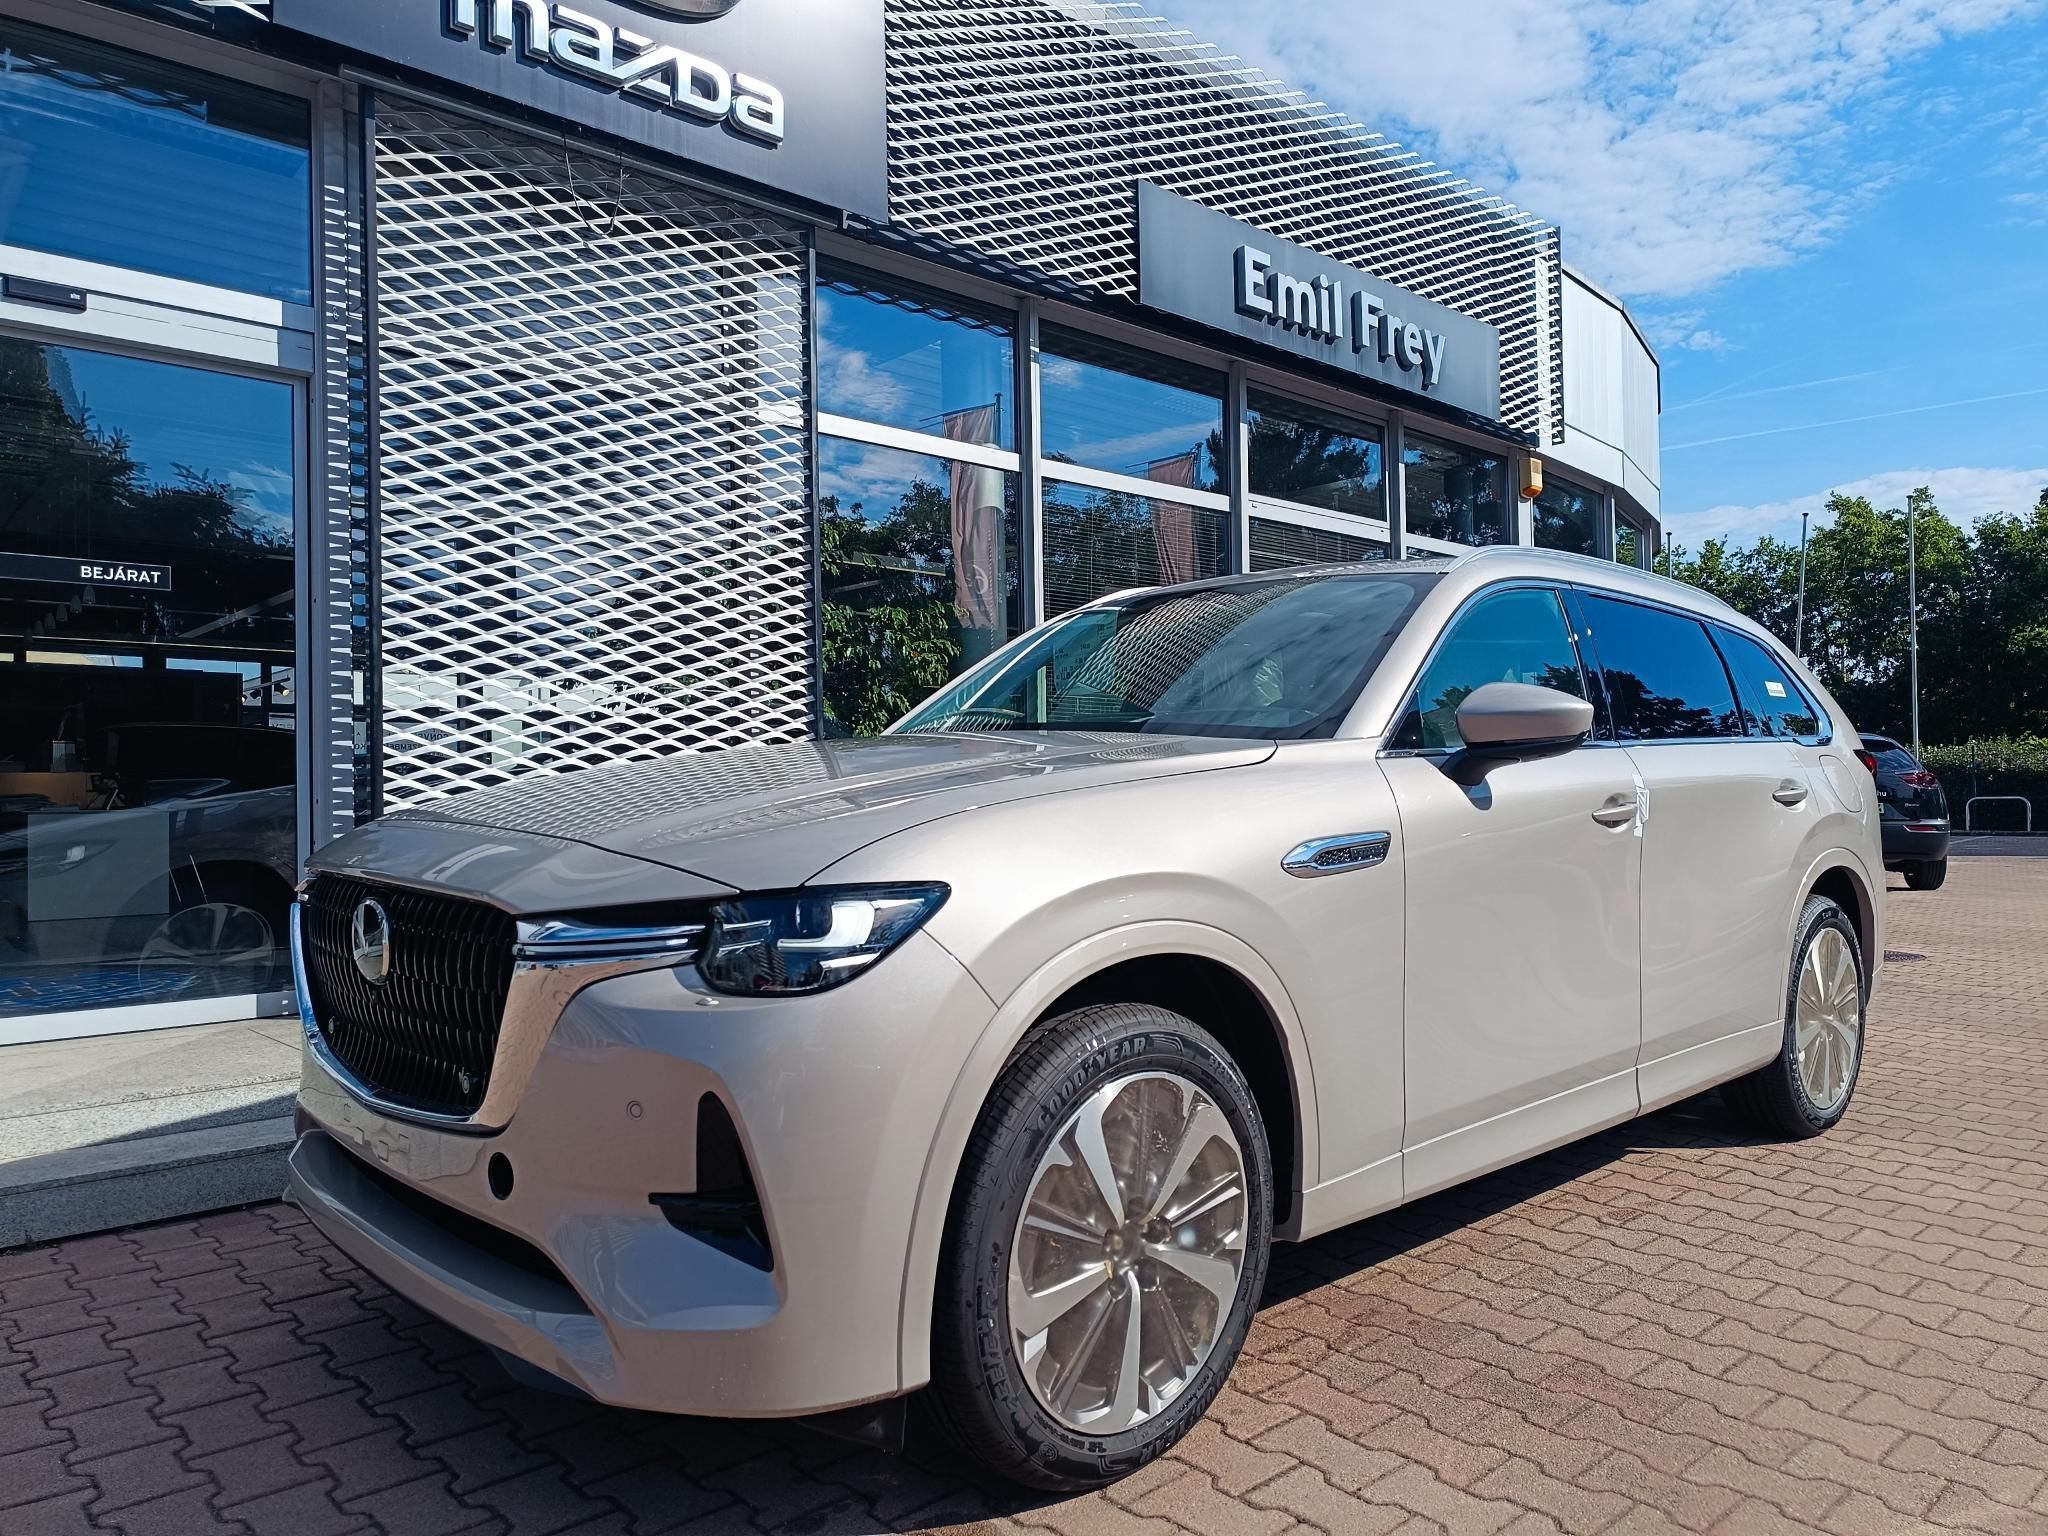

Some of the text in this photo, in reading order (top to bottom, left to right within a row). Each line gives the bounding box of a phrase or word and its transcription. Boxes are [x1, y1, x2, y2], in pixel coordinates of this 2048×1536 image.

[450, 0, 785, 143] mazda
[1237, 246, 1447, 388] Emil Frey
[81, 566, 161, 583] BEJÁRAT
[1036, 1036, 1148, 1133] GOODYEAR
